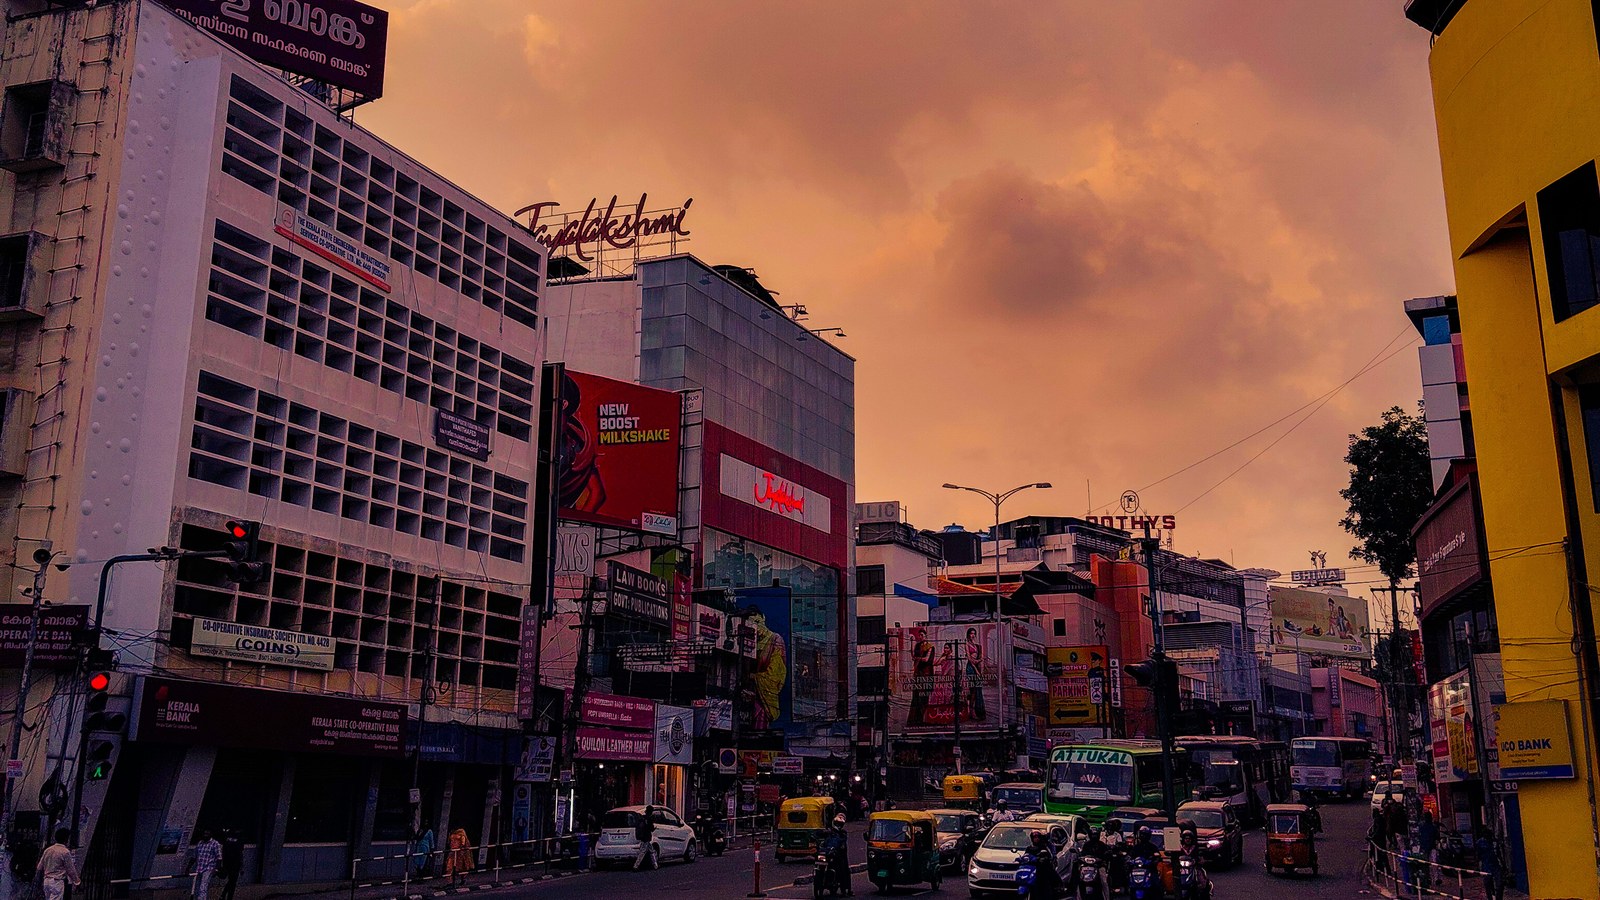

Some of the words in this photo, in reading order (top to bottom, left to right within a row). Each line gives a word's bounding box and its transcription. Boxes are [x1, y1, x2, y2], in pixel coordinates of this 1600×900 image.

[600, 404, 629, 416] NEW
[600, 417, 640, 430] BOOST
[600, 429, 670, 444] MILKSHAKE
[866, 504, 895, 518] LIC
[1293, 569, 1338, 580] BHIMA
[616, 568, 636, 588] LAW
[637, 576, 666, 597] BOOKS
[631, 597, 669, 621] PUBLICATIONS
[202, 620, 243, 636] CO-OPERATIVE
[244, 626, 274, 640] INSURANCE
[275, 631, 297, 644] SOCIETY
[235, 637, 300, 658] (COINS)
[1053, 686, 1087, 697] PARKING
[167, 700, 200, 713] KERALA
[166, 711, 191, 722] BANK
[312, 717, 332, 728] KERALA
[334, 719, 348, 729] STATE
[349, 721, 385, 732] CO-OPERATIVE
[386, 723, 399, 733] BANK
[582, 737, 605, 752] QUILON
[606, 738, 633, 753] LEATHER
[634, 740, 650, 754] MART
[1518, 738, 1552, 750] BANK
[1055, 750, 1129, 764] ATTUKAL
